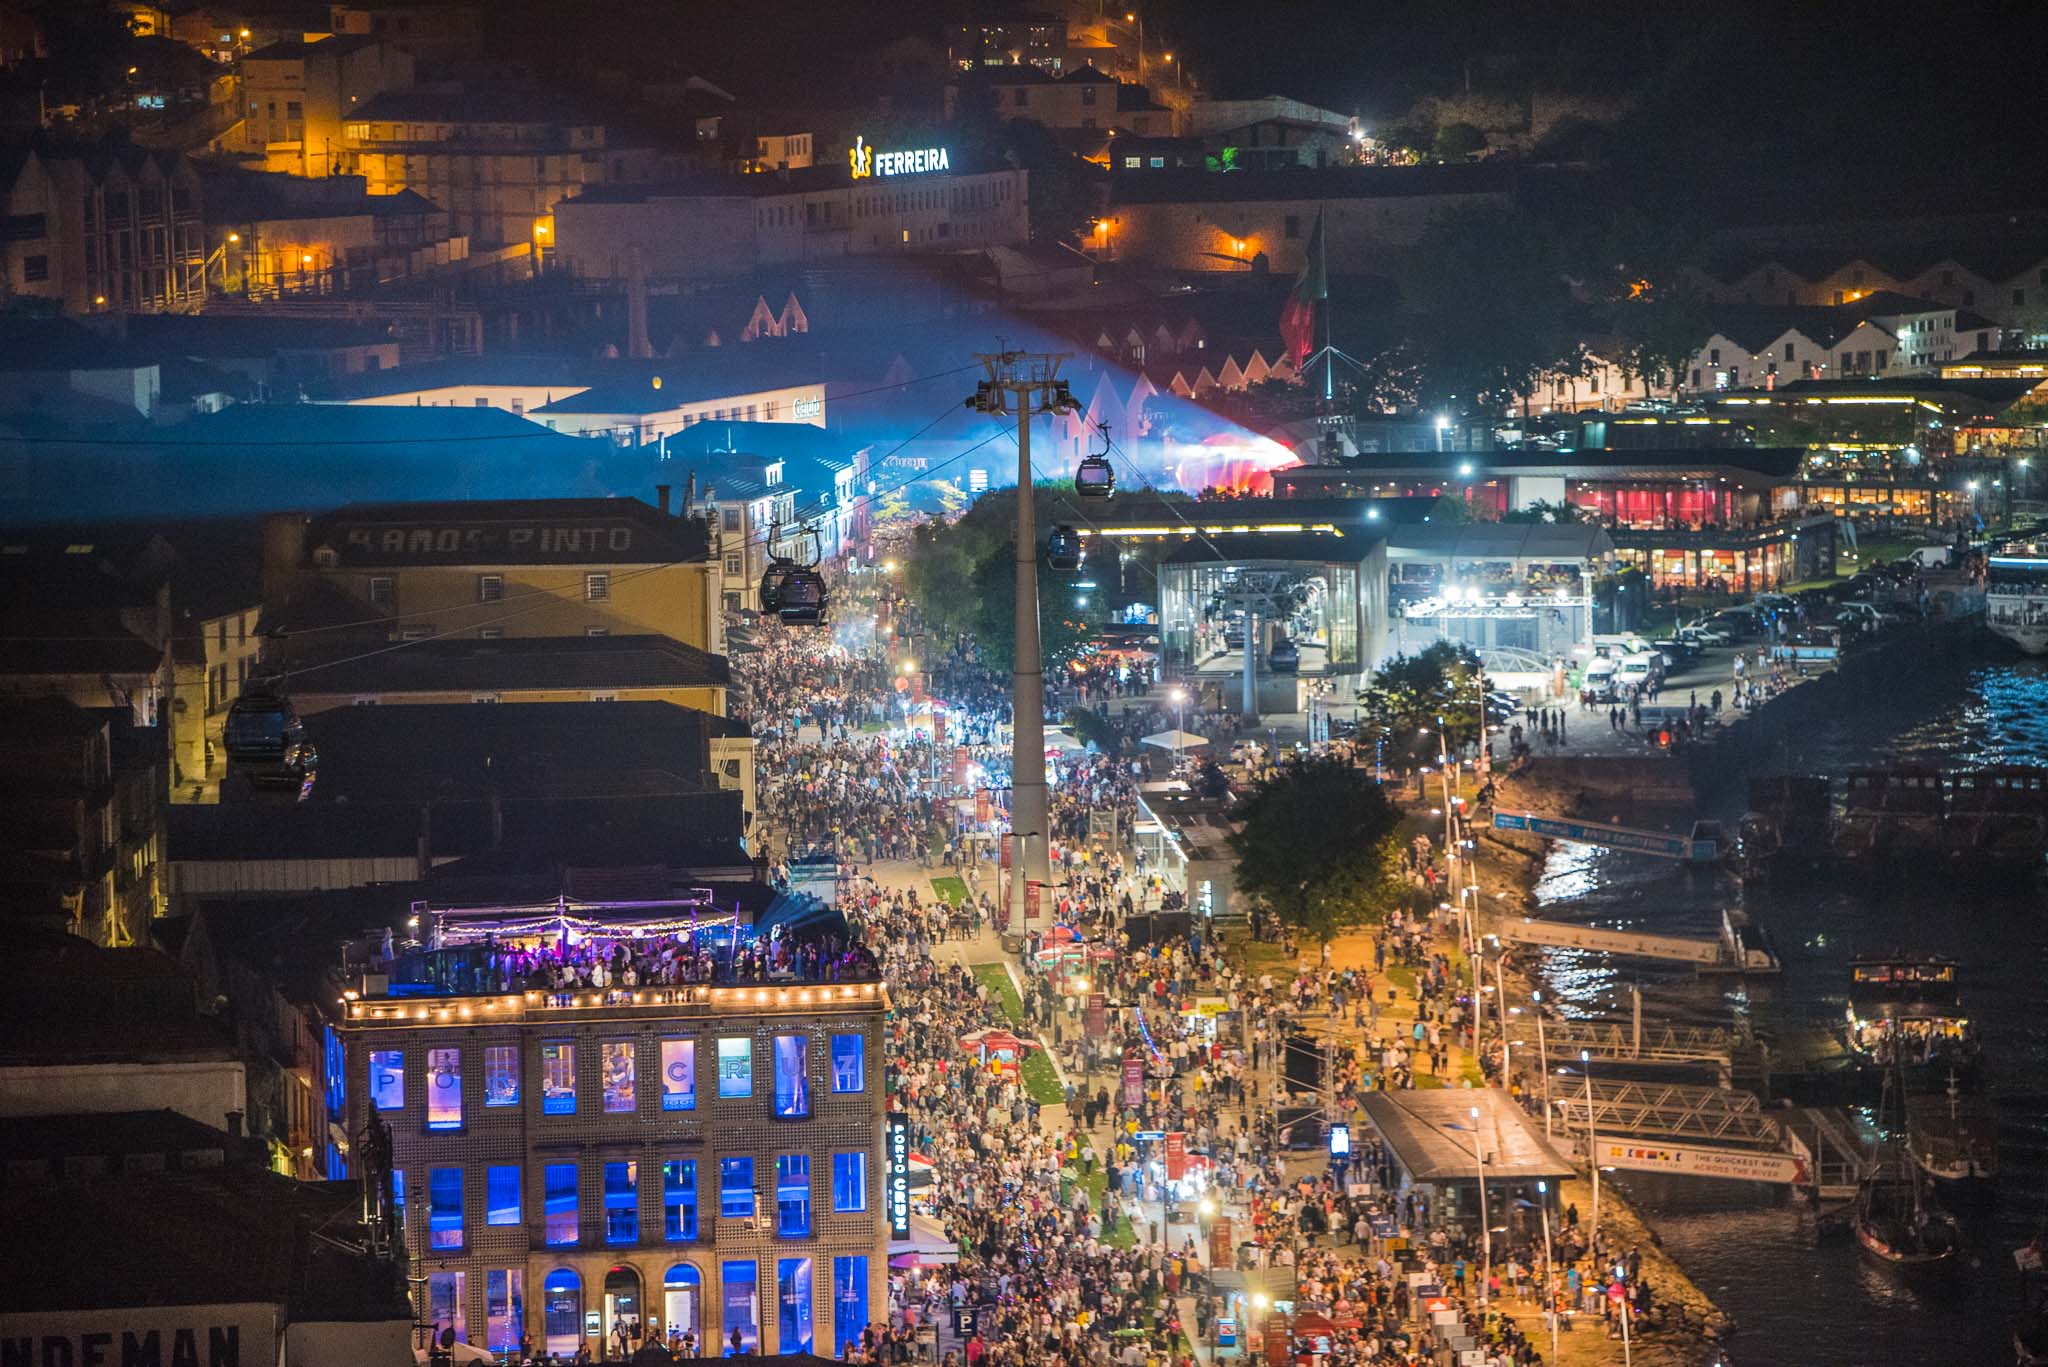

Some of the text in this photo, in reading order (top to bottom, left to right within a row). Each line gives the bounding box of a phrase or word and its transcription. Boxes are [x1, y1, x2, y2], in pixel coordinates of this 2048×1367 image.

[876, 148, 949, 176] FERREIRA
[508, 527, 633, 552] PINTO
[668, 1056, 857, 1082] CRUZ
[1693, 1163, 1779, 1177] ACROSS THE RIVER
[1695, 1154, 1783, 1168] THE QUICKEST WAY
[894, 1124, 907, 1230] PORTO CRUZ
[960, 1315, 973, 1329] P
